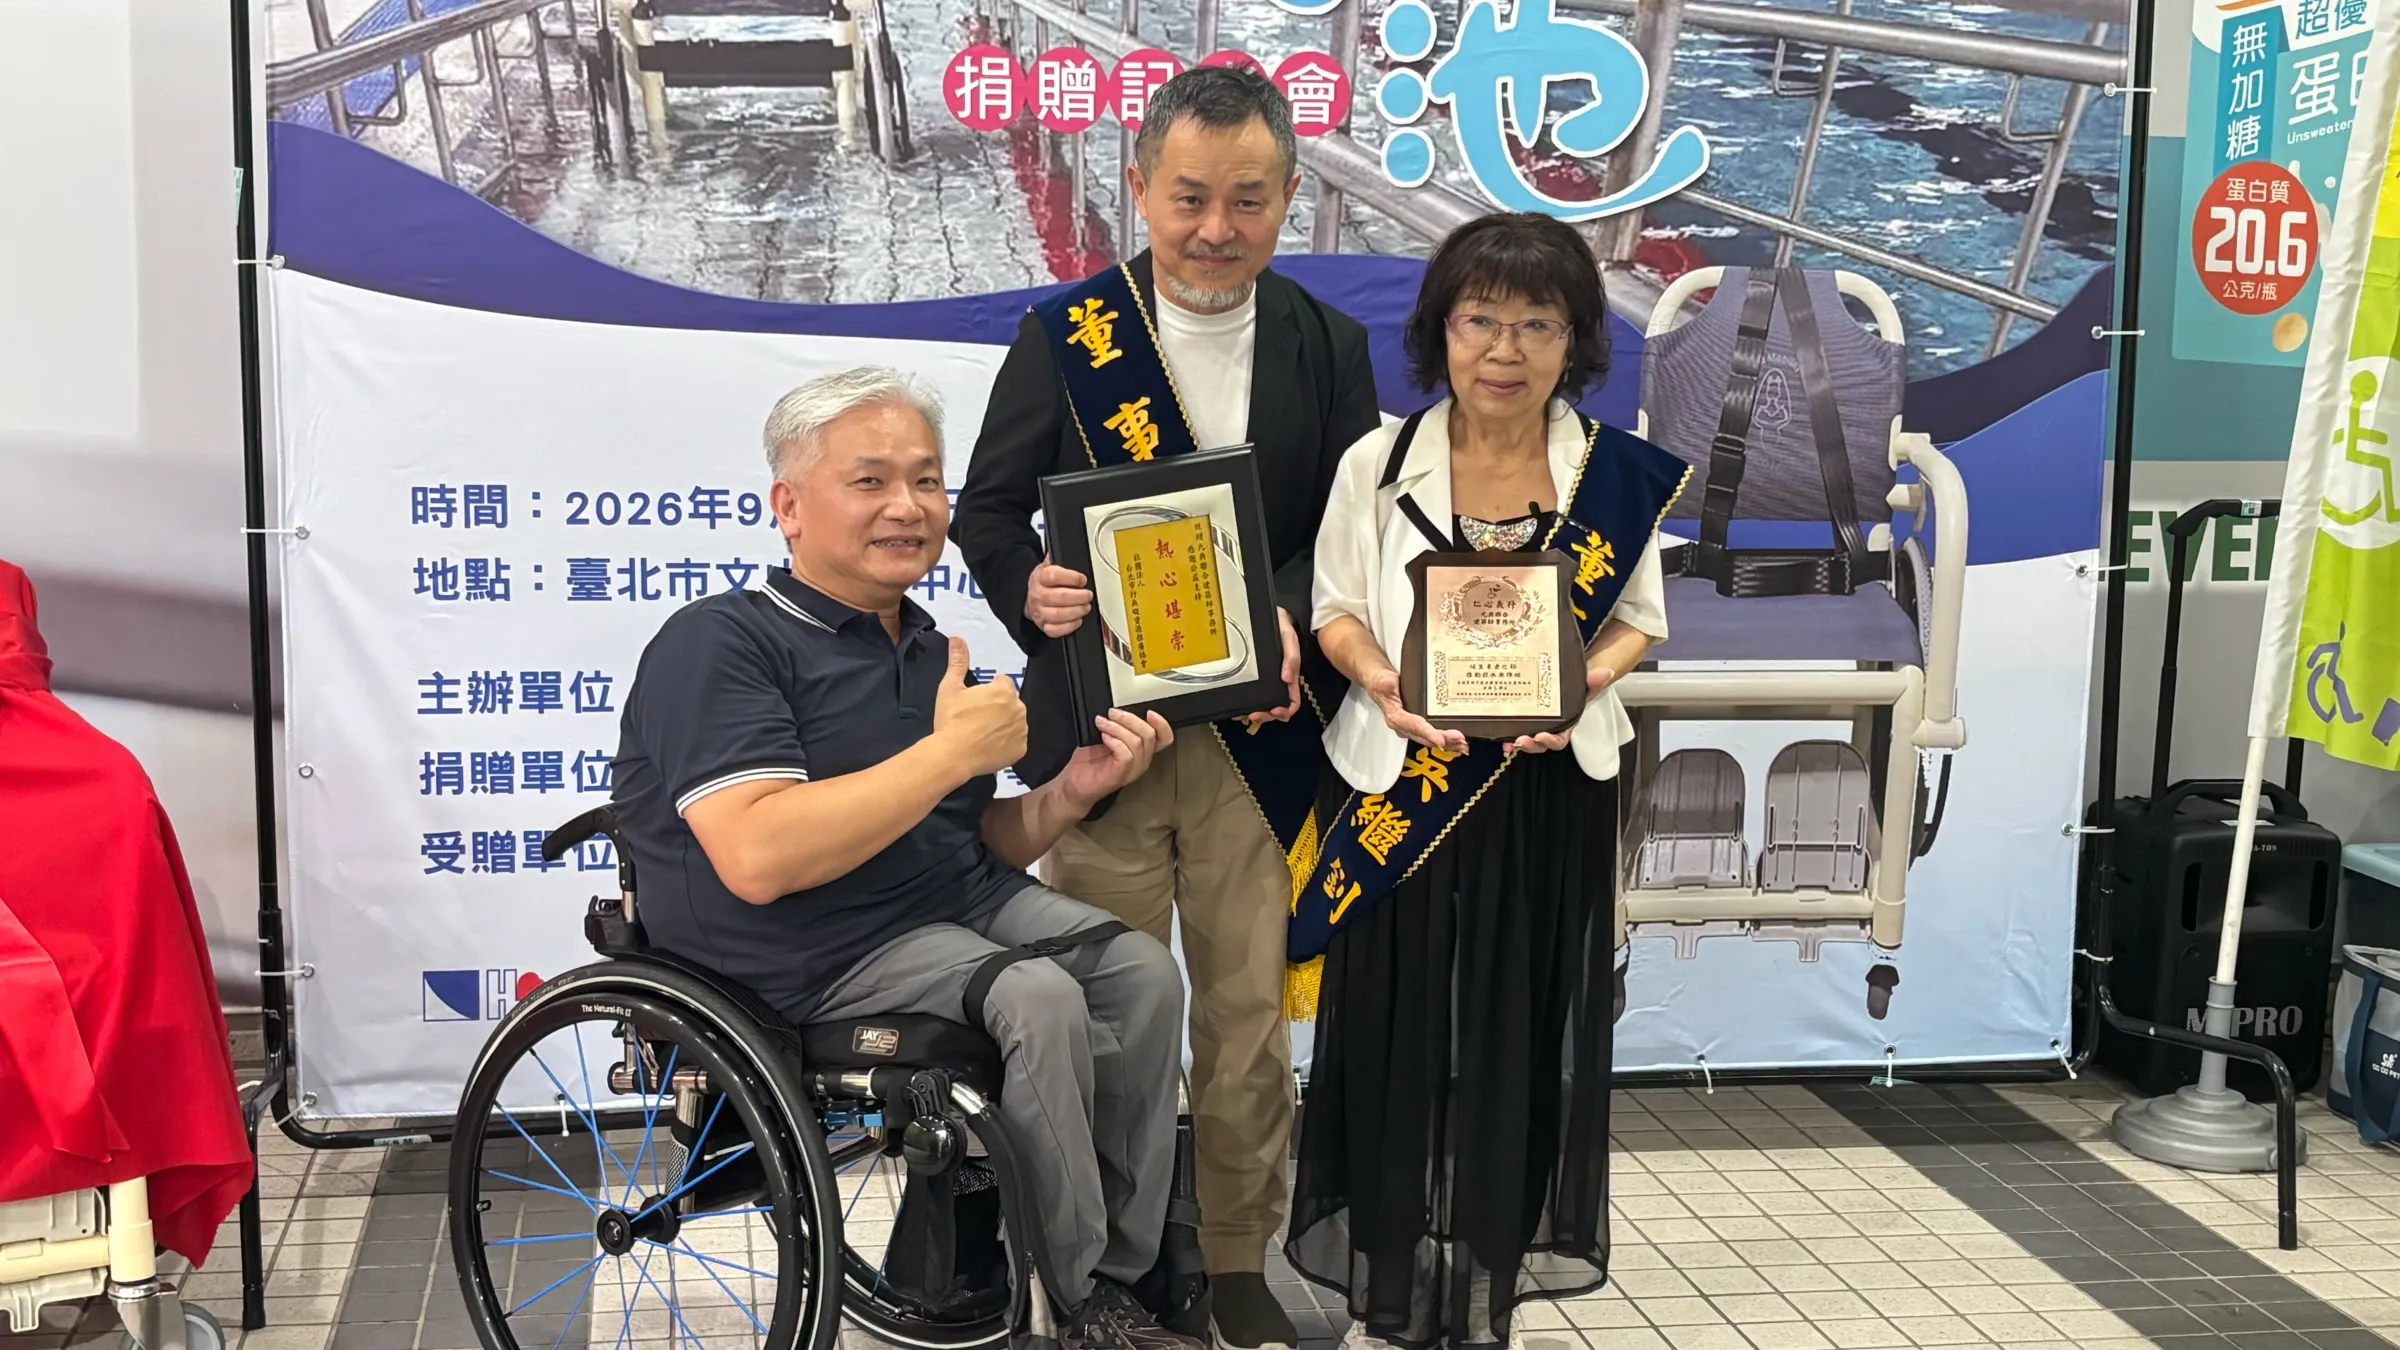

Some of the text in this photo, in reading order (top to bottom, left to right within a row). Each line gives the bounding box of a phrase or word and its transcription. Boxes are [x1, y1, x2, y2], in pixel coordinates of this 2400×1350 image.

[955, 56, 1341, 125] 捐贈記會
[2225, 21, 2268, 161] 無加糖
[2225, 177, 2291, 205] 蛋白質
[2204, 206, 2308, 278] 20.6
[2223, 279, 2278, 301] 公克/瓶
[411, 483, 778, 530] 時間：2026年9
[2098, 511, 2278, 582] EVE
[413, 556, 790, 603] 地點：臺北市文
[417, 670, 615, 715] 主辦單位
[419, 749, 614, 796] 捐贈單位
[420, 830, 617, 875] 受贈單位
[581, 1004, 593, 1013] The
[2186, 1005, 2303, 1038] MPRO
[860, 1029, 879, 1041] JAY
